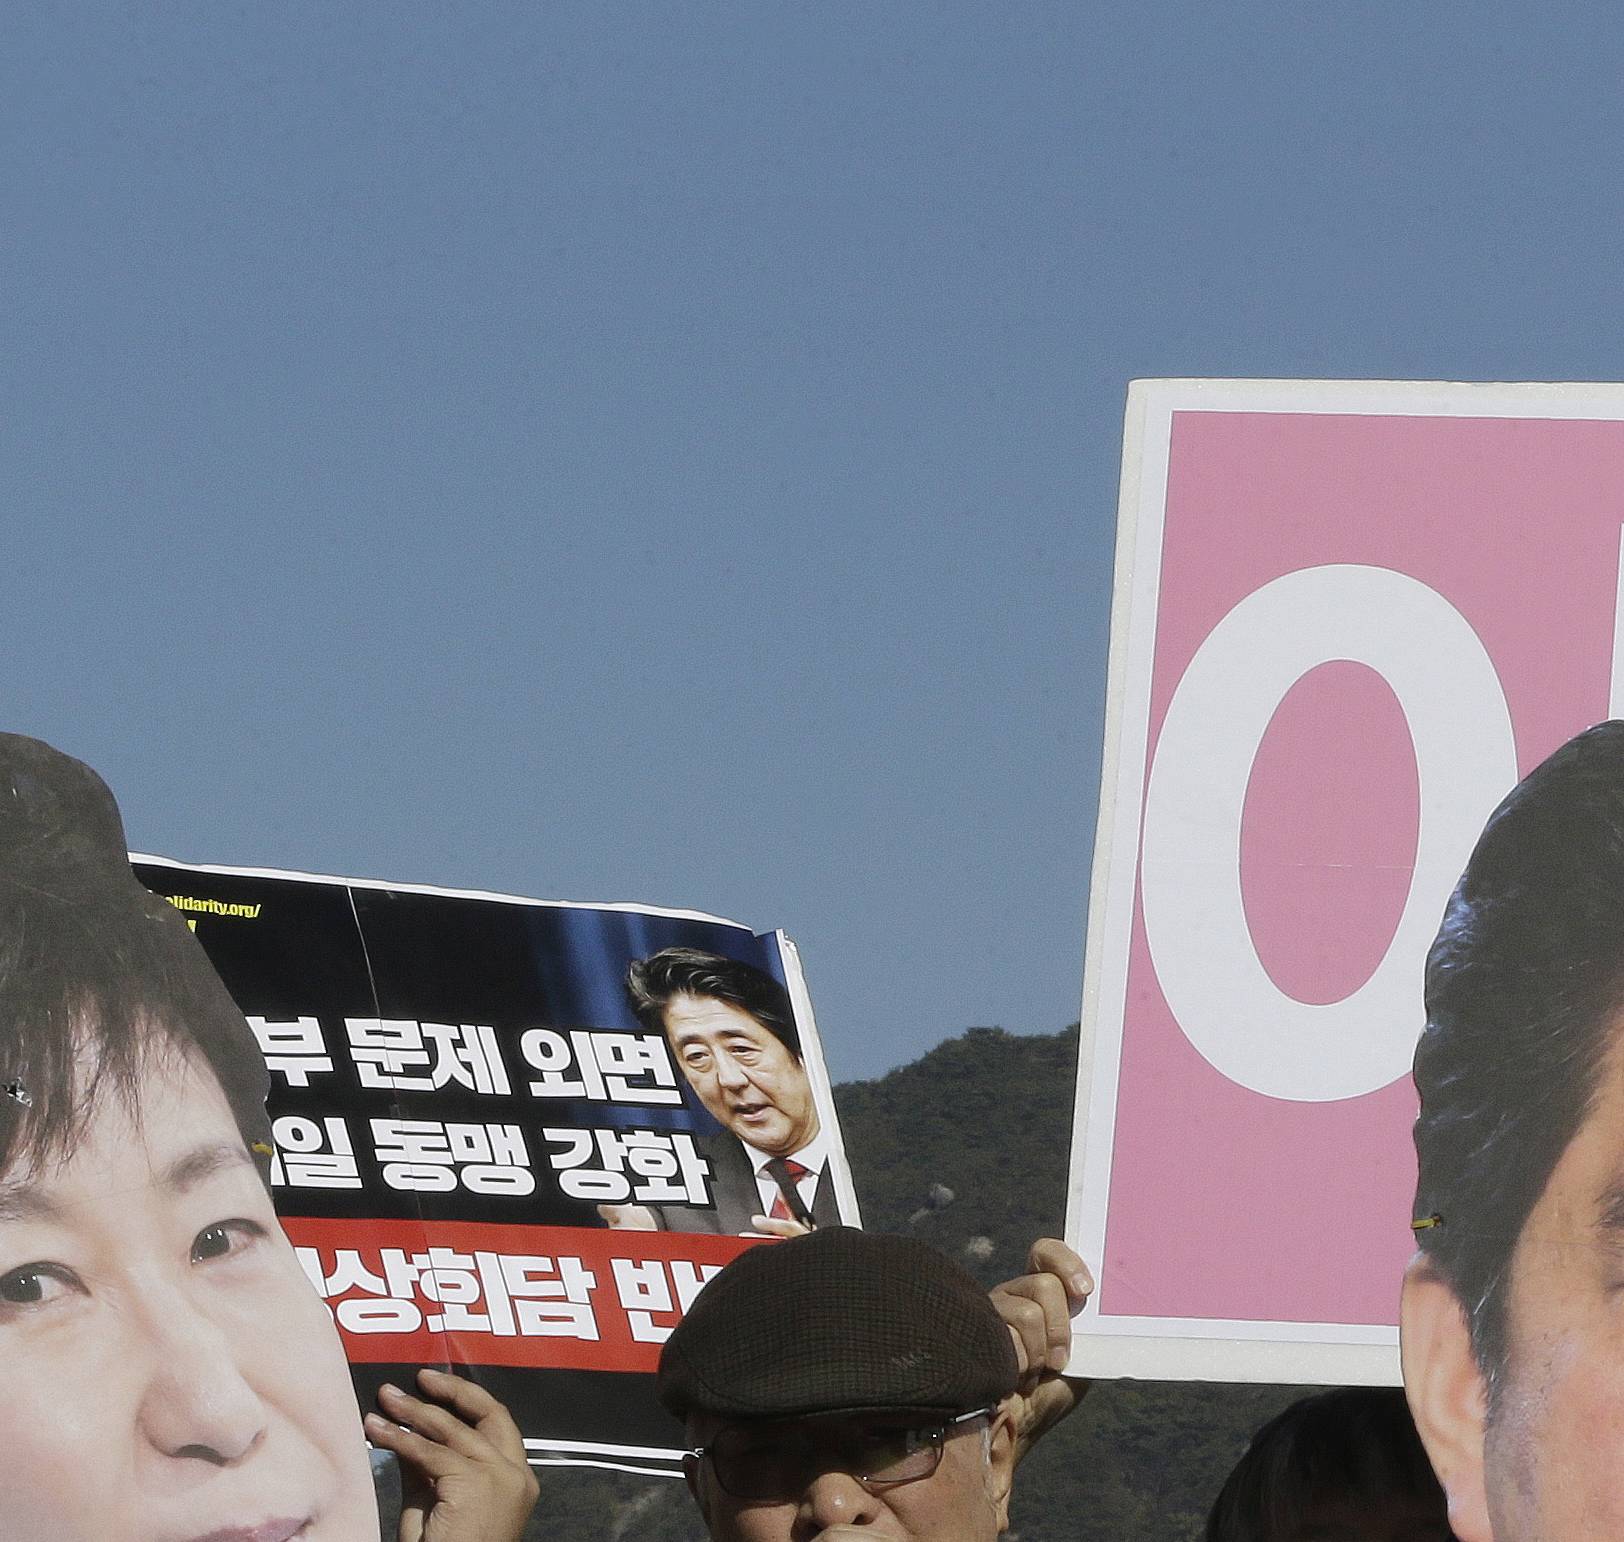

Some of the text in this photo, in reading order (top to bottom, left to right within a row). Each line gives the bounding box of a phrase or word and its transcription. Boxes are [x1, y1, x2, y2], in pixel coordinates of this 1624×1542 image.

[344, 1017, 512, 1095] 문제
[520, 1028, 683, 1104] 외면
[270, 1116, 710, 1205] 일 동맹 강화
[293, 1246, 723, 1344] 상회담 반
